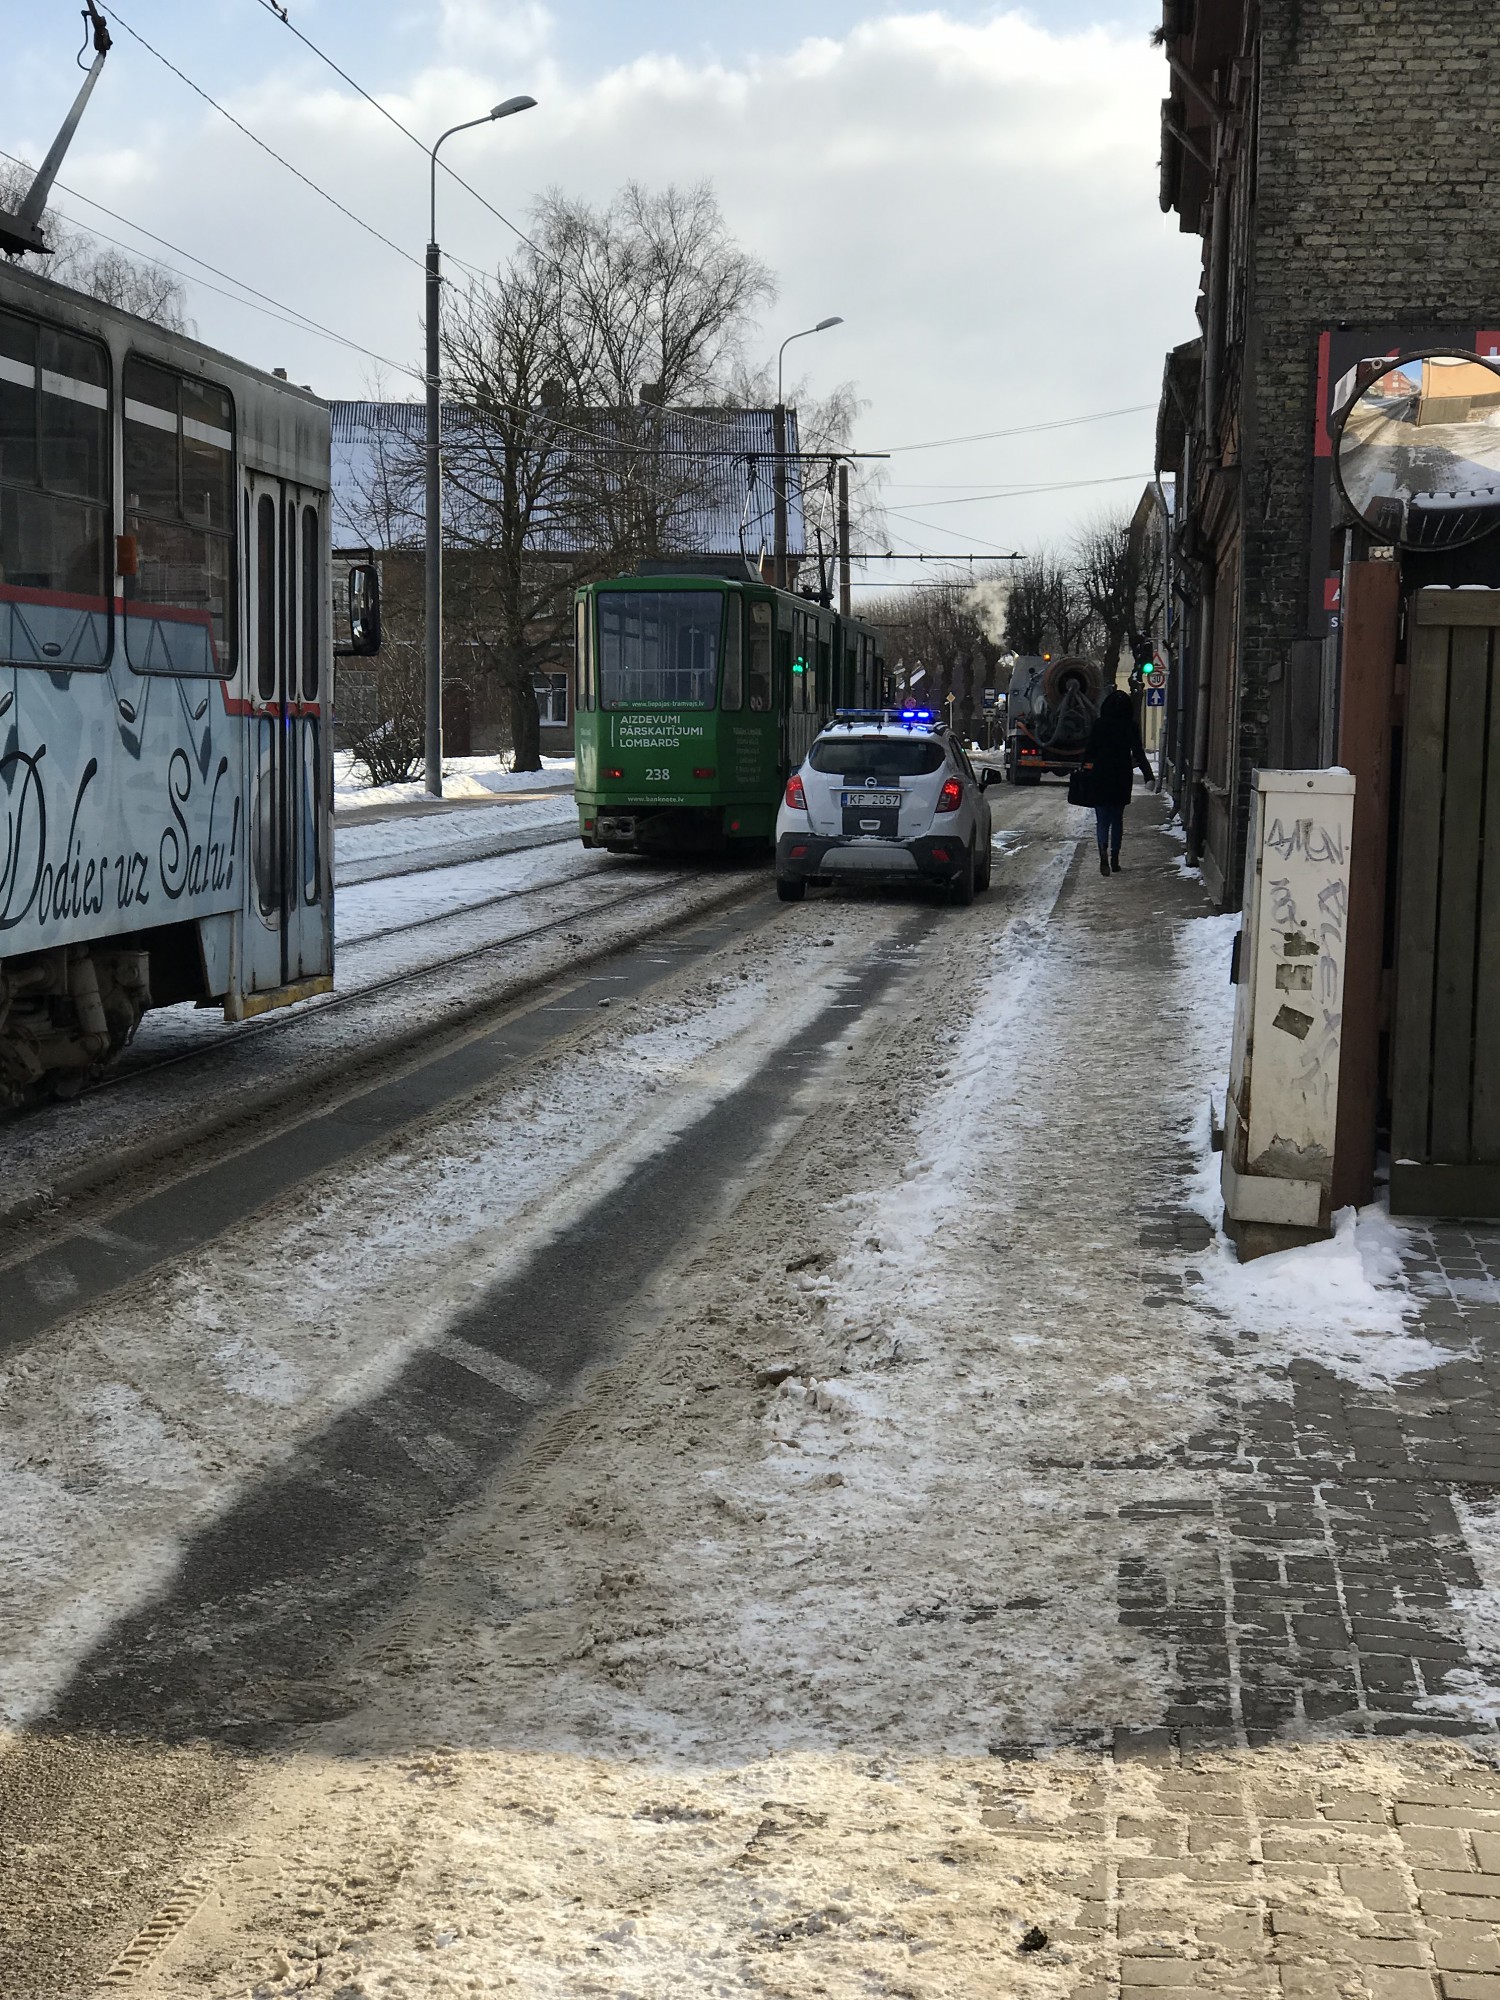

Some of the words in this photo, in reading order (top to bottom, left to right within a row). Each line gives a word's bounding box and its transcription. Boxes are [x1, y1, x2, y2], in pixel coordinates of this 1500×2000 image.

[1151, 674, 1161, 683] 30
[620, 715, 681, 724] AIZDEVUMI
[619, 725, 703, 736] PĀRSKAITĪJUMI
[619, 738, 680, 748] LOMBARDS
[645, 768, 670, 781] 238
[872, 794, 899, 805] 2057
[0, 743, 108, 931] Dodies
[114, 851, 149, 909] uz
[159, 747, 240, 900] Salu!
